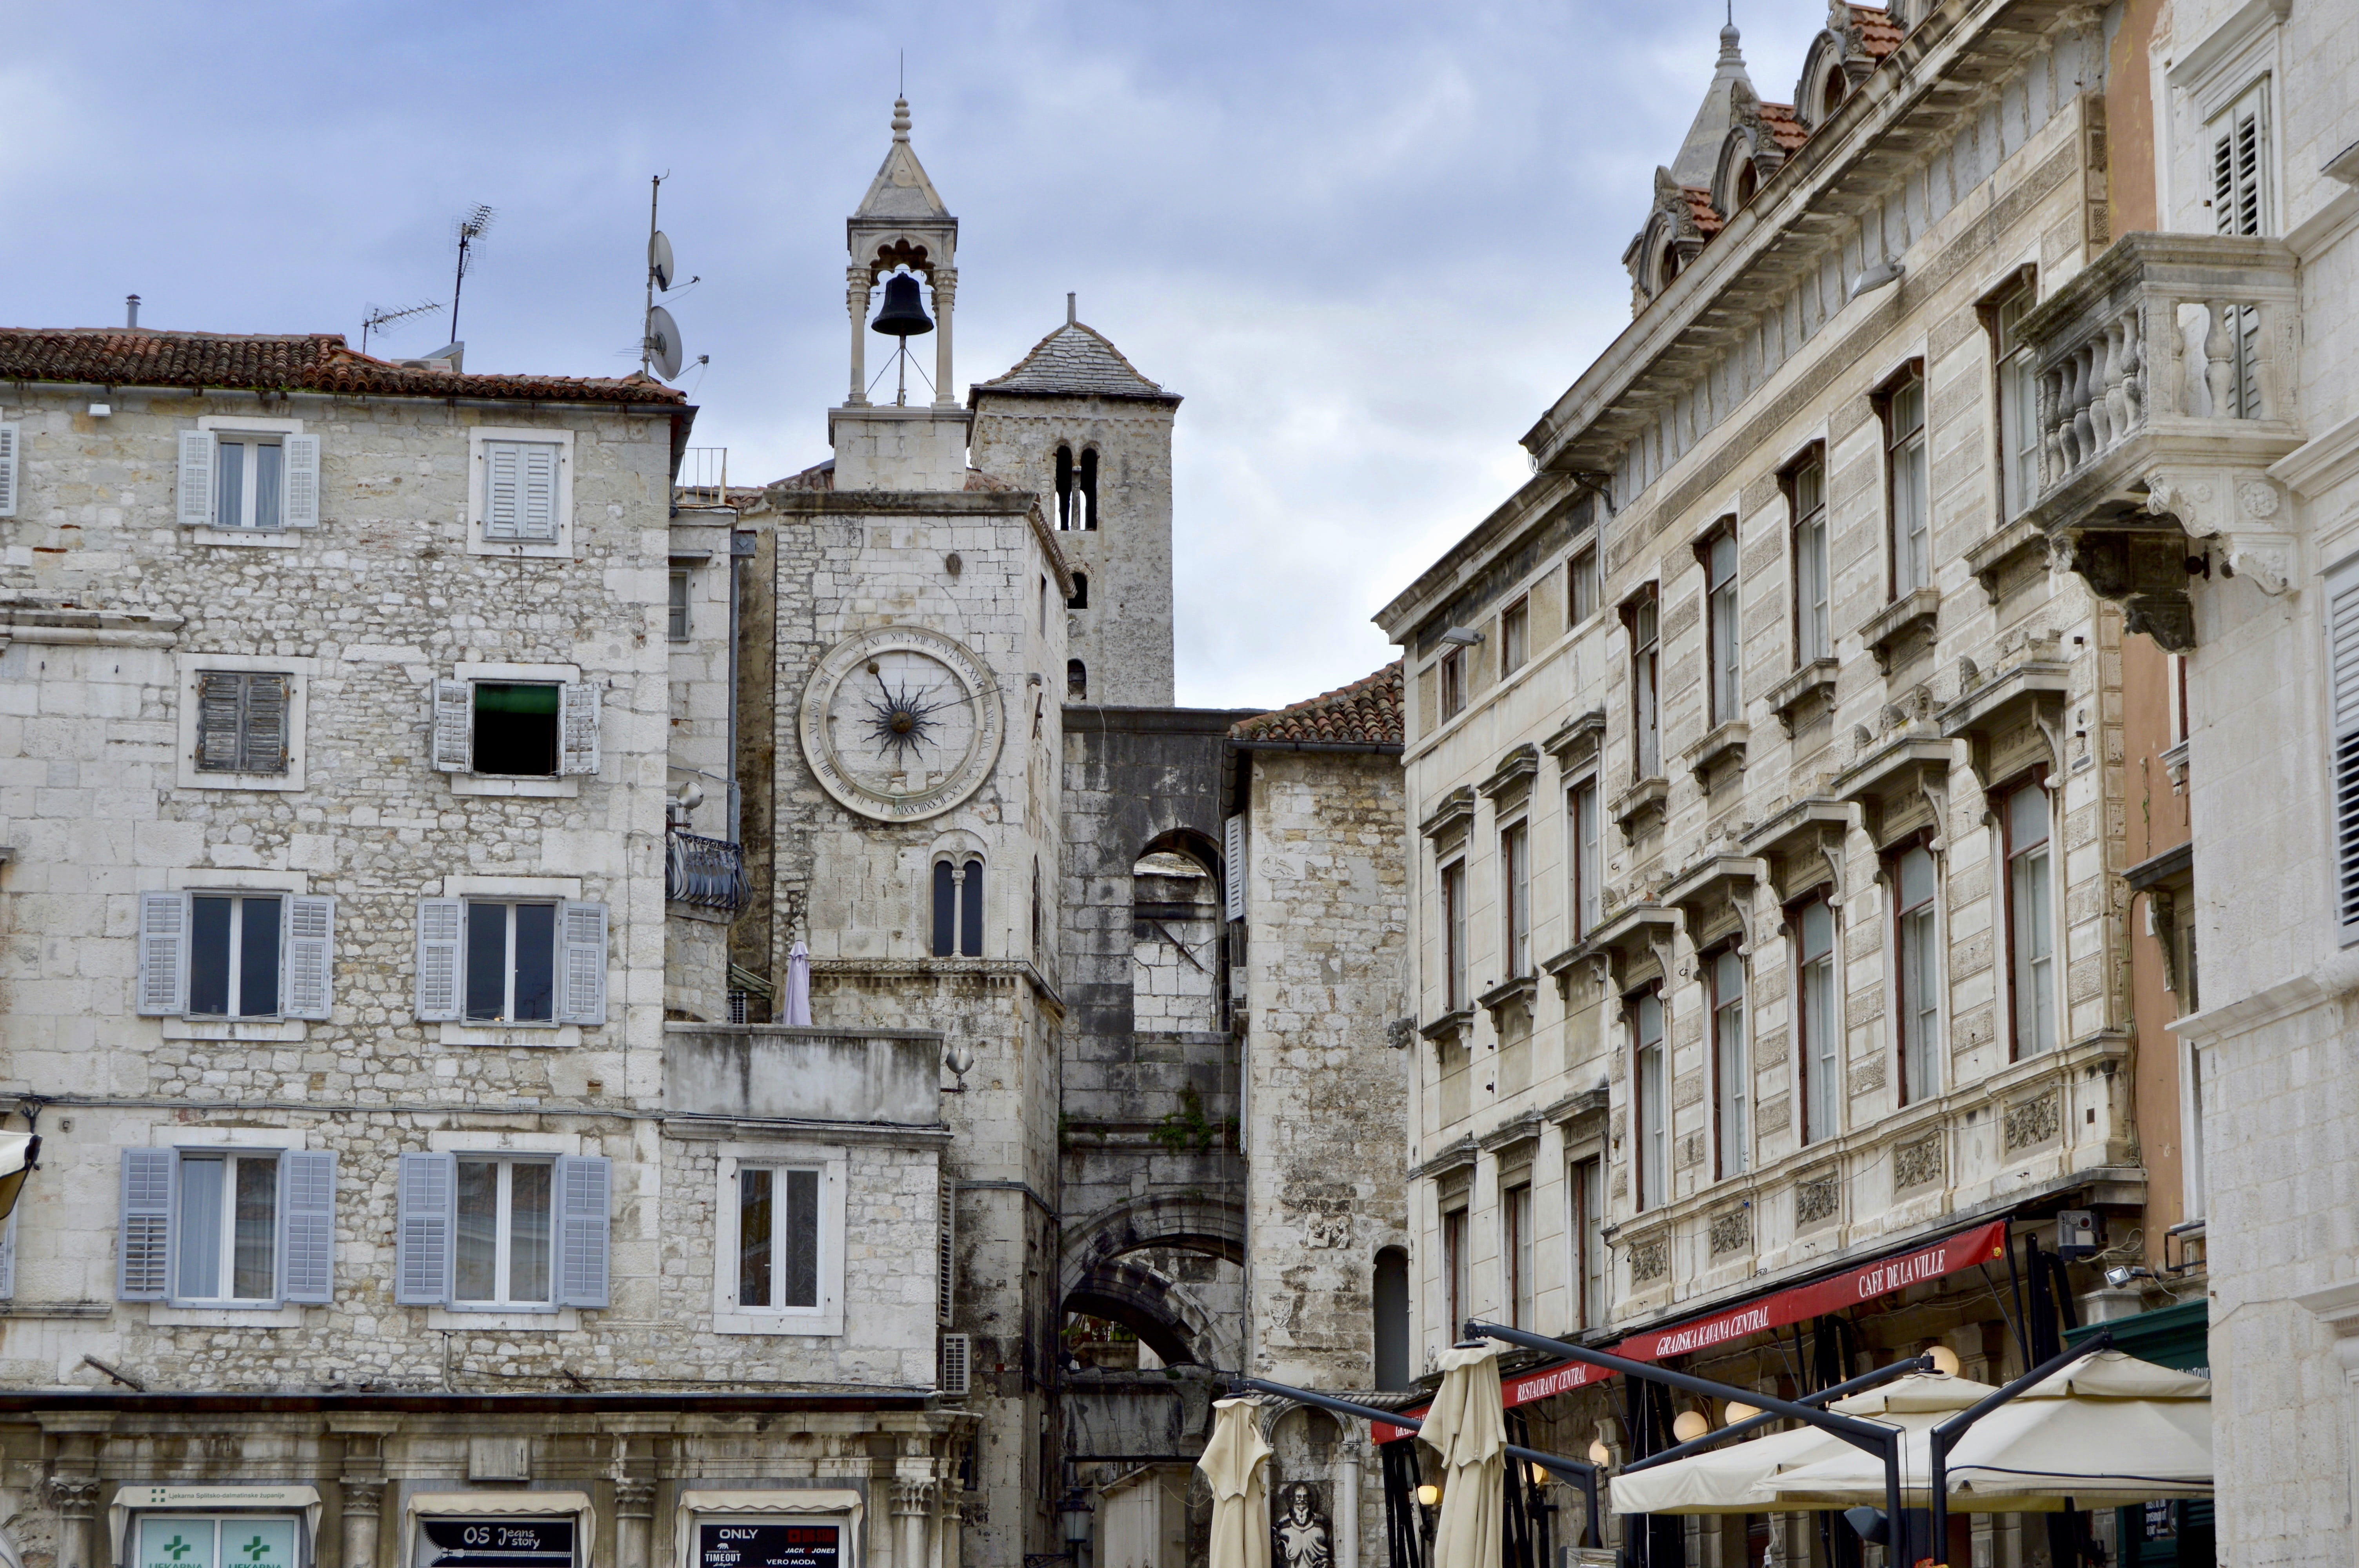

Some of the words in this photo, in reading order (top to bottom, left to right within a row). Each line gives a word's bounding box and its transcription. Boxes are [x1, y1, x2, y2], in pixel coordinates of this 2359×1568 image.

[869, 637, 880, 646] XI
[891, 633, 903, 642] XII
[913, 634, 929, 645] XIII
[952, 653, 969, 666] XV
[810, 698, 821, 711] VII
[984, 710, 994, 729] XVIII
[809, 723, 818, 734] VI
[981, 734, 993, 751] XIX
[821, 764, 834, 777] IIII
[836, 782, 847, 793] III
[856, 796, 865, 806] II
[880, 804, 885, 812] I
[1859, 1263, 1884, 1298] CAFÉ
[1886, 1264, 1899, 1289] DE
[1900, 1259, 1914, 1285] LA
[1914, 1249, 1945, 1279] VILLE
[1656, 1329, 1697, 1356] GRADSKA
[1696, 1319, 1729, 1346] KAVANA
[1731, 1306, 1769, 1337] CENTRAL
[1517, 1374, 1558, 1402] RESTAURANT
[1559, 1365, 1587, 1390] CENTRAL
[464, 1527, 490, 1544] OS
[498, 1527, 535, 1546] Jeans
[719, 1529, 758, 1539] ONLY
[816, 1529, 836, 1543] STAR
[511, 1537, 540, 1550] story
[705, 1553, 741, 1562] TIMEOUT
